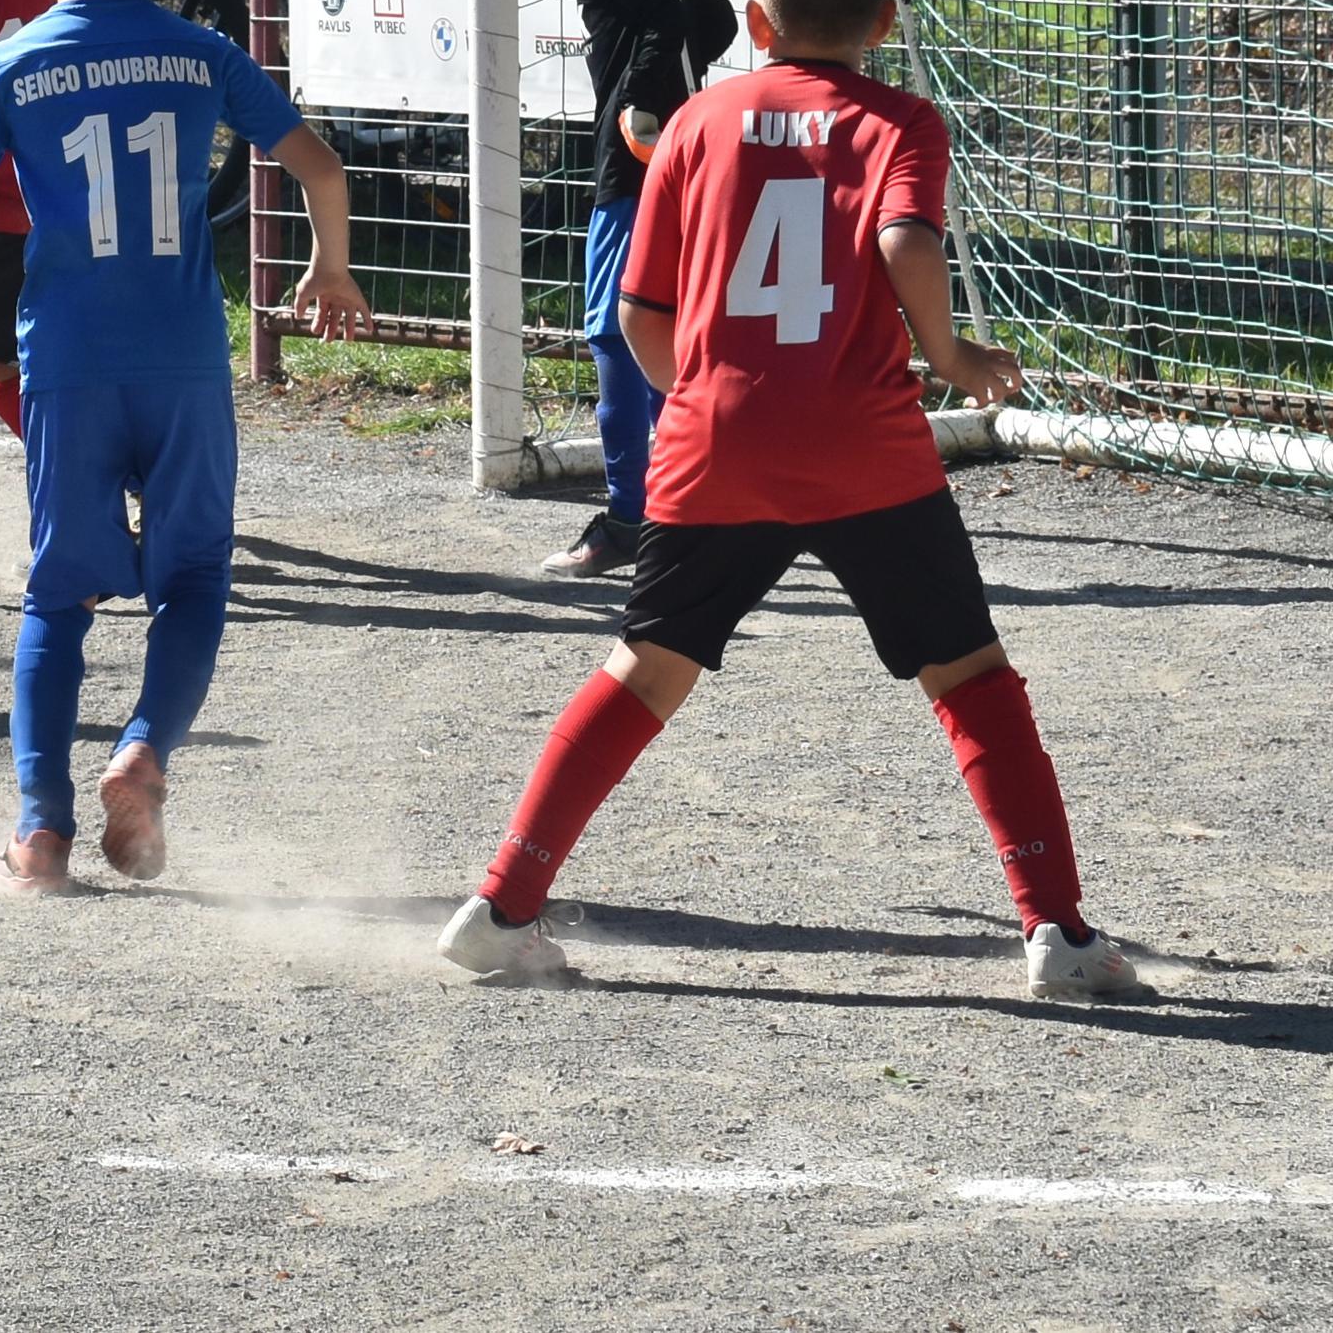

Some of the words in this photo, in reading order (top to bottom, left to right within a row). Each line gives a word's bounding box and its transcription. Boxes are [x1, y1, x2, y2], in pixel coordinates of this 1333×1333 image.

[318, 19, 351, 33] RAVLIS
[373, 20, 407, 36] PUBEC
[13, 64, 81, 107] SENCO
[85, 55, 212, 89] DOUBRAVKA
[741, 109, 838, 148] LUKY
[61, 112, 181, 259] 11
[725, 177, 834, 345] 4
